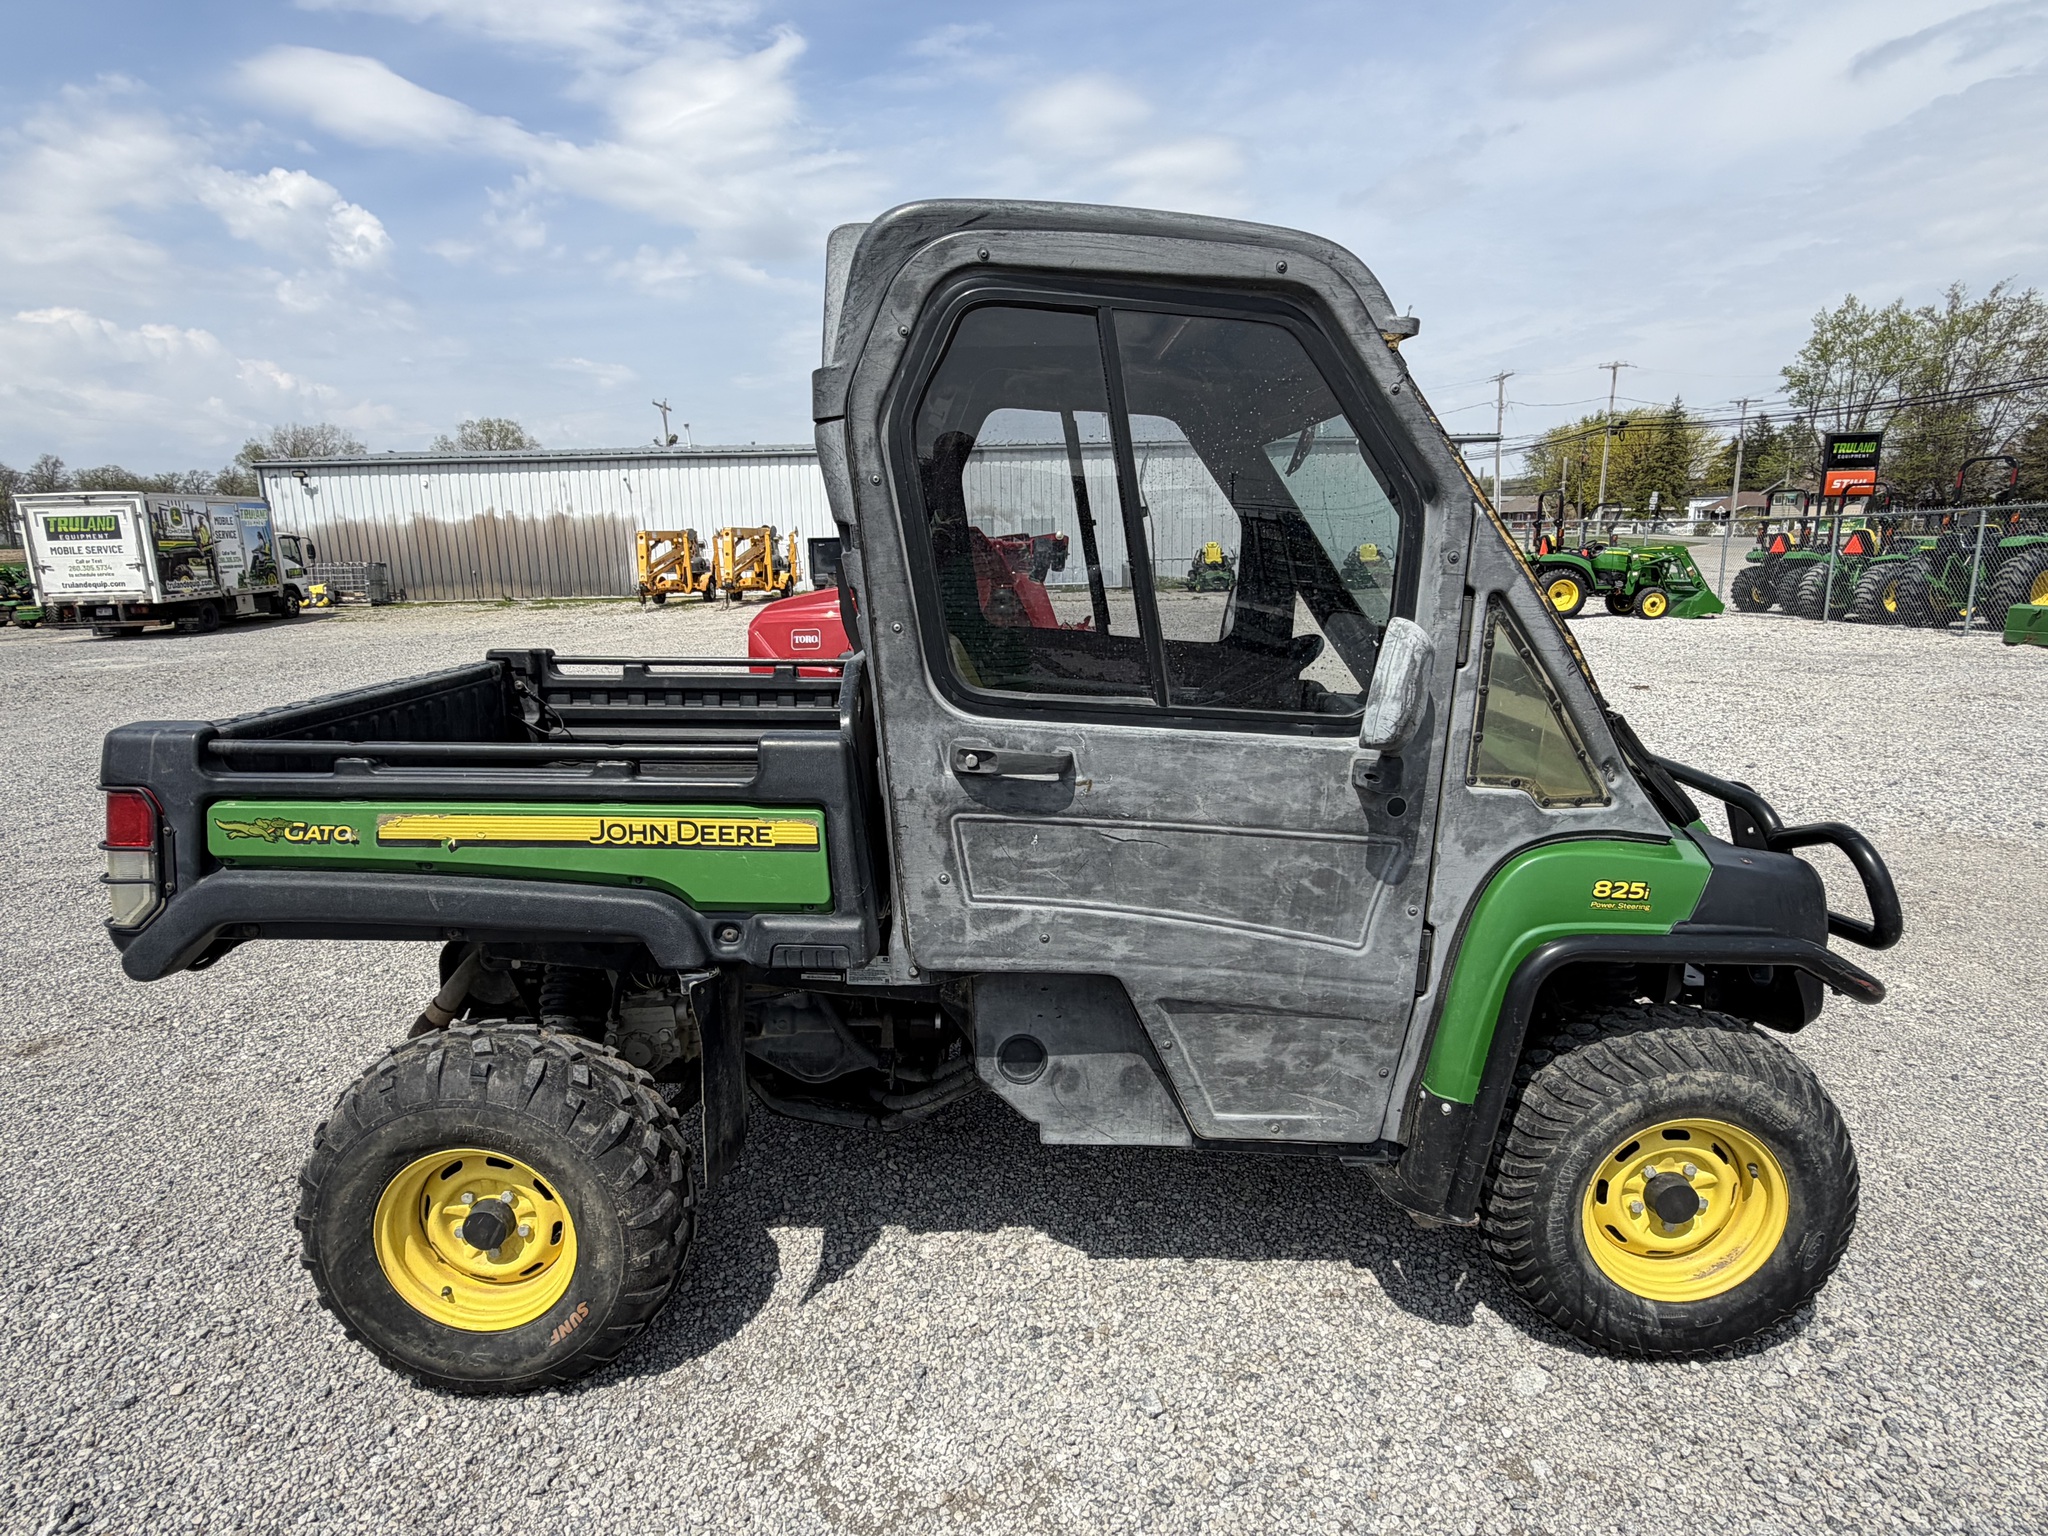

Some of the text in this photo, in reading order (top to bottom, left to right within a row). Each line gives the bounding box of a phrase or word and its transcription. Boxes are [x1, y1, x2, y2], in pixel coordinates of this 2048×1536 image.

[1833, 442, 1877, 454] TRULAND
[47, 516, 115, 532] TRULAND
[214, 516, 233, 525] MOBILE
[215, 530, 237, 539] SERVICE
[50, 545, 124, 555] MOBILE SERVICE
[62, 581, 126, 589] trulandequip.com
[793, 635, 818, 643] TORO
[284, 822, 358, 843] GATO
[590, 819, 772, 843] JOHN DEERE
[1592, 880, 1650, 900] 825i
[1617, 902, 1651, 911] Steering
